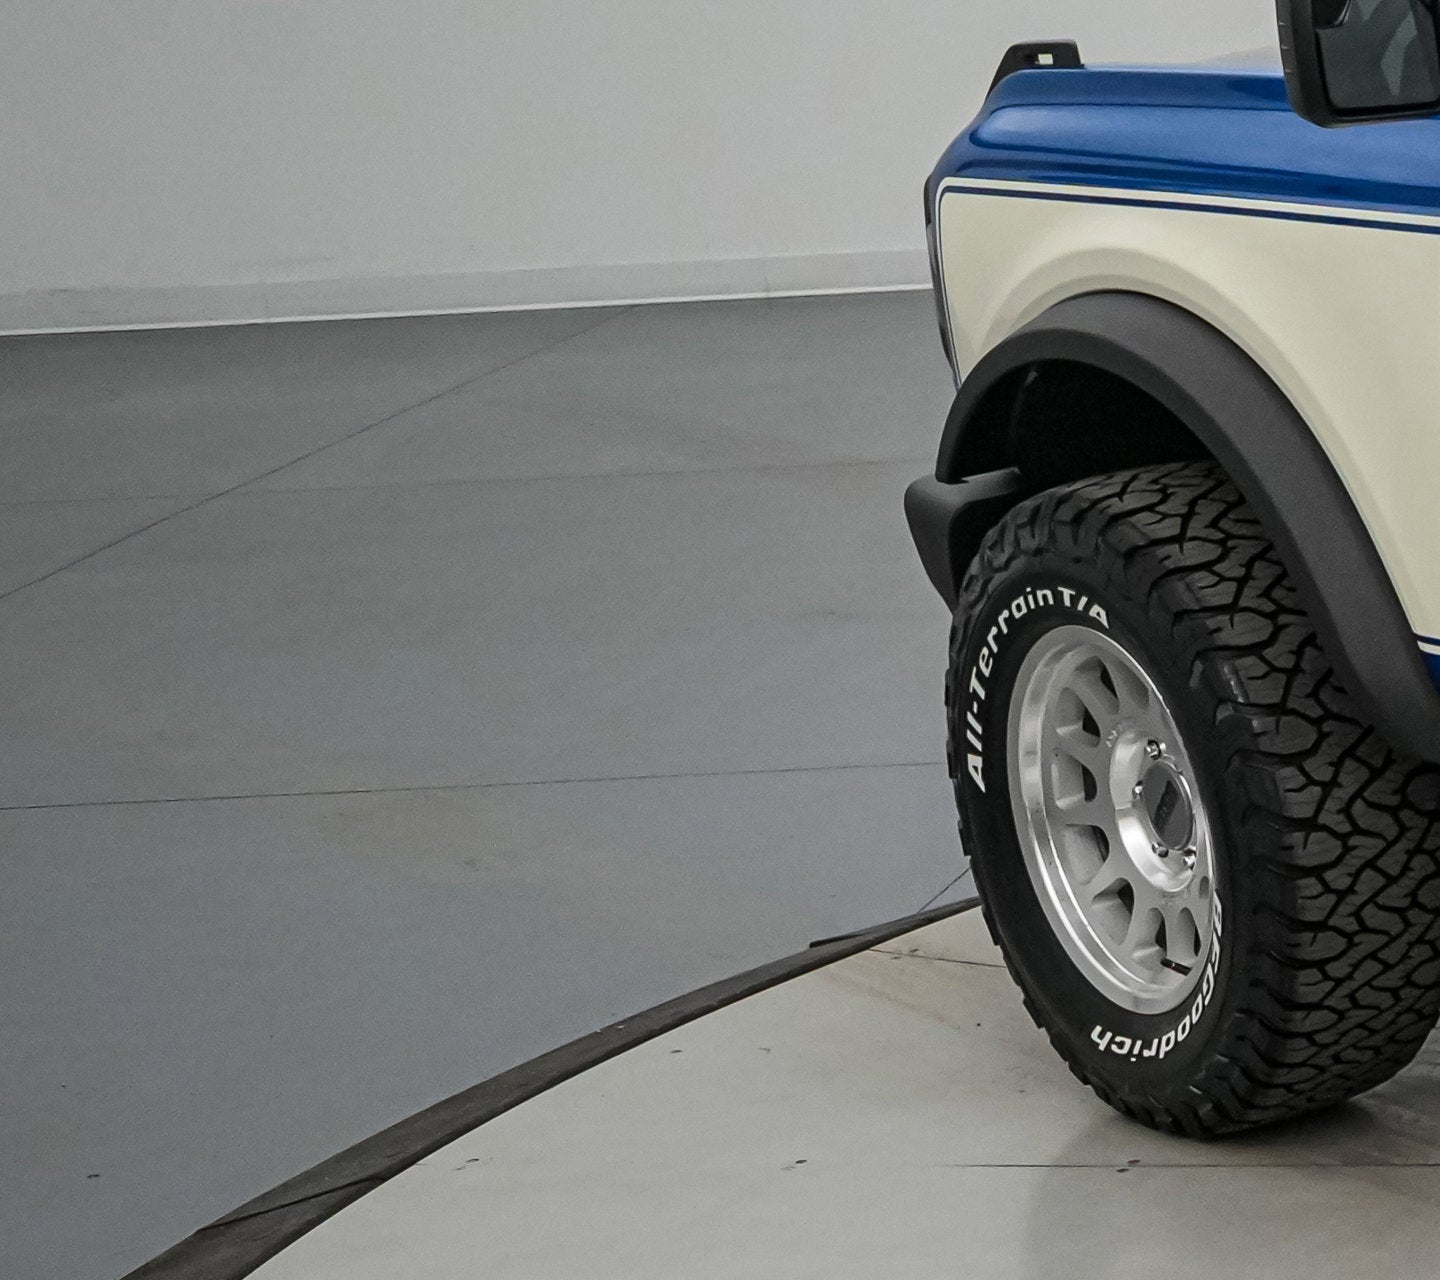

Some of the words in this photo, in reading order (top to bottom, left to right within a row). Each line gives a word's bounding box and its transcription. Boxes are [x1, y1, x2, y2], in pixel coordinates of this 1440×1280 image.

[966, 587, 1054, 793] All-Terrain
[1057, 586, 1109, 629] T/A
[1090, 890, 1223, 1062] BFGoodrich
